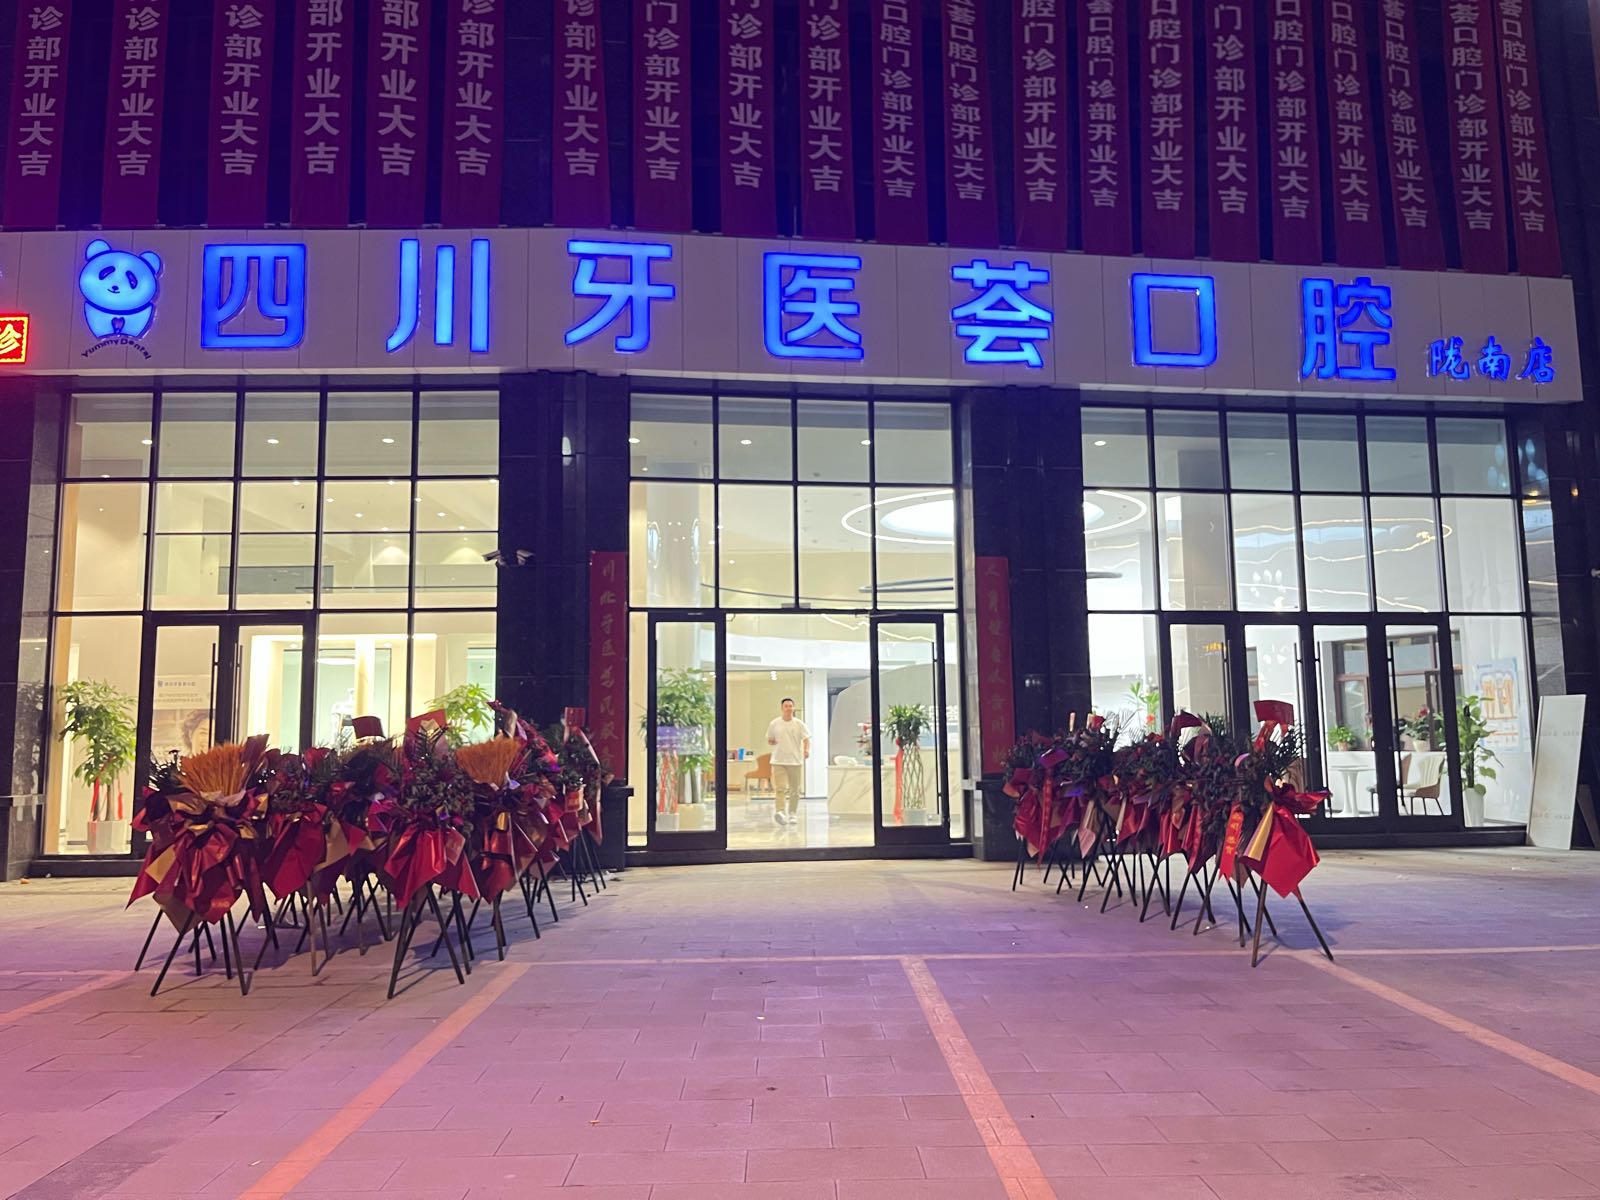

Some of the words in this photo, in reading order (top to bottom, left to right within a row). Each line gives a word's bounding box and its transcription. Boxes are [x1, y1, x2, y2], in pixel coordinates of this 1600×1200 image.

[19, 6, 62, 176] 诊部开业大吉
[221, 5, 263, 175] 诊部开业大吉
[304, 0, 343, 174] 部开业大吉
[379, 0, 418, 175] 部开业大吉
[643, 0, 680, 180] 门诊部开业大吉
[947, 0, 985, 200] 荟口腔门诊部开业大吉
[1021, 0, 1058, 202] 腔门诊部开业大吉
[1212, 4, 1248, 214] 门诊部开业大吉
[1273, 0, 1309, 218] 口腔门诊部开业大吉
[201, 238, 1397, 382] 四川牙医荟口腔
[1427, 335, 1556, 383] 陇南店
